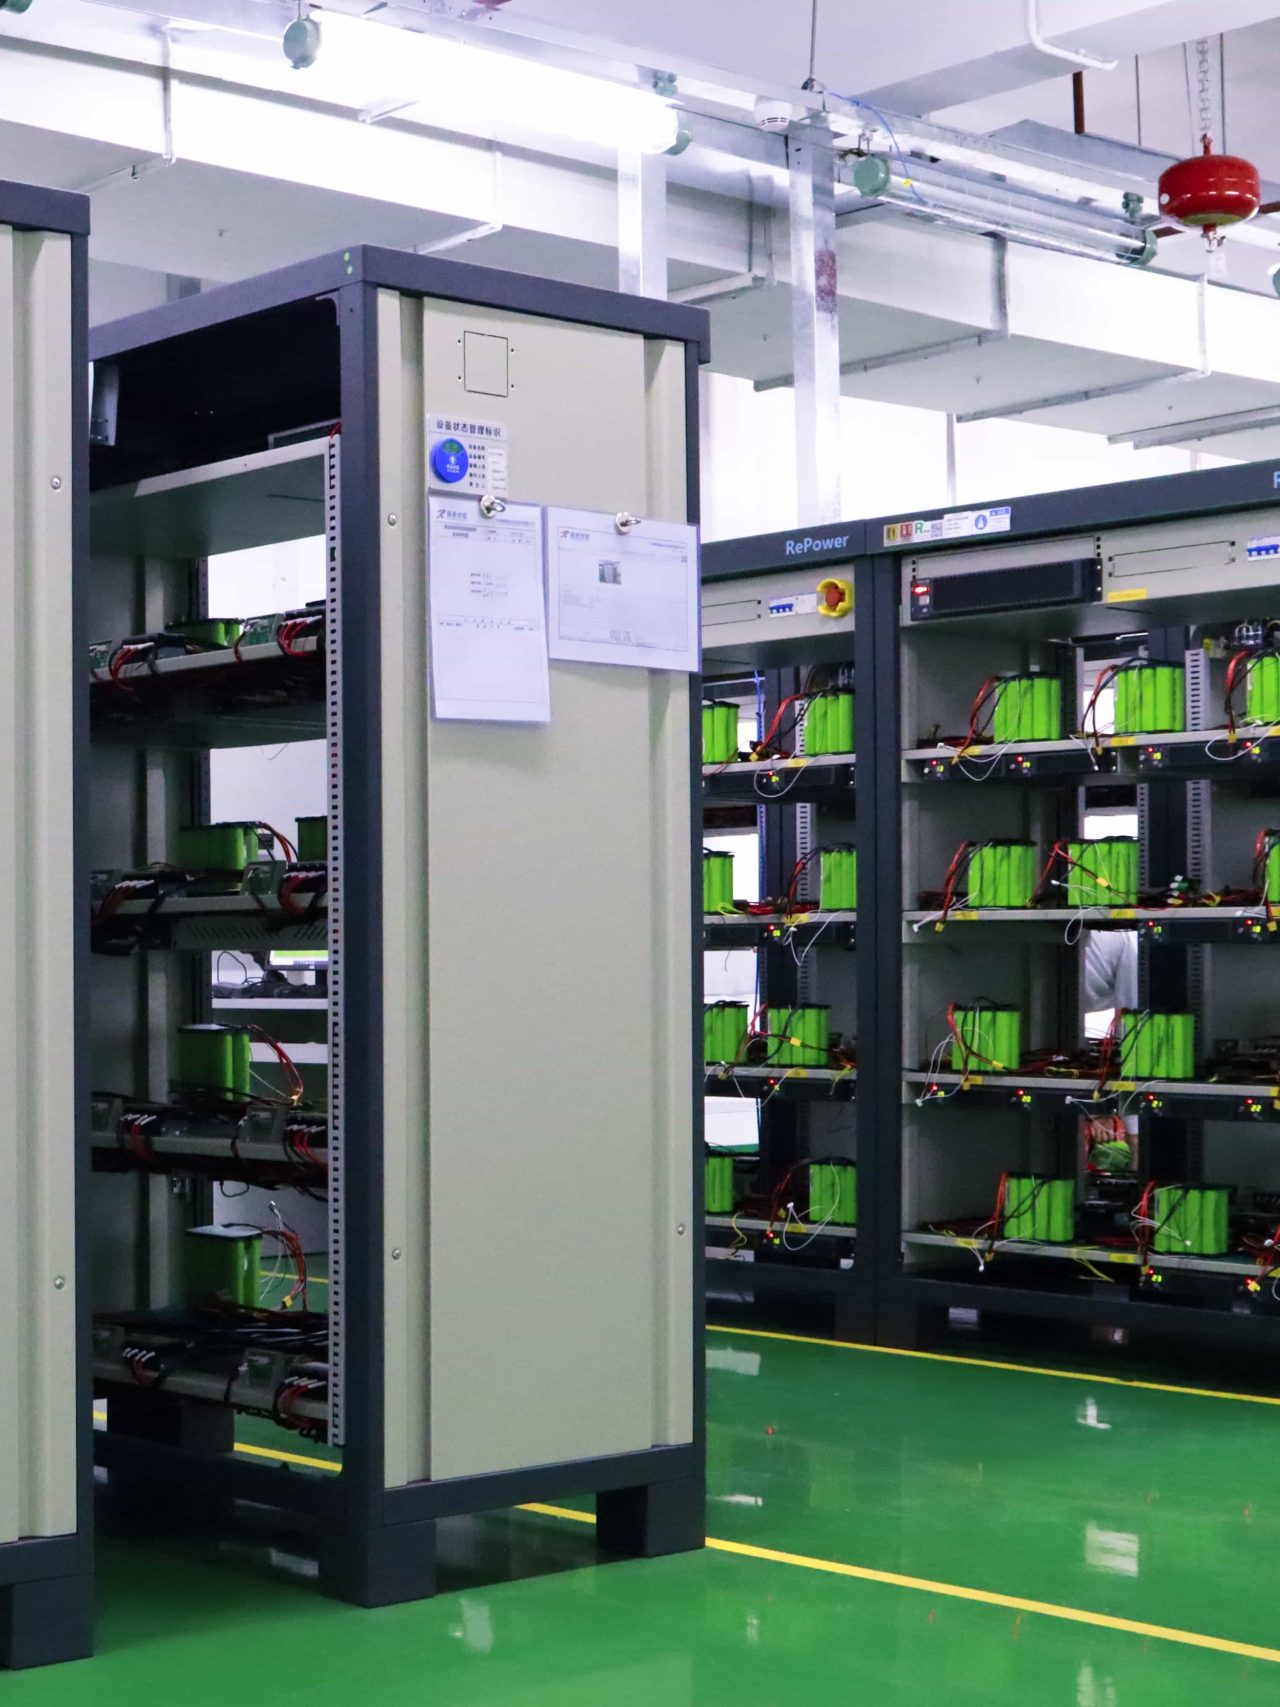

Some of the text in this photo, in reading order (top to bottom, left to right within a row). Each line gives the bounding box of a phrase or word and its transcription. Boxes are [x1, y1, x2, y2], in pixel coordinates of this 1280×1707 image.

[436, 420, 501, 437] 设备状态管理标识
[786, 535, 849, 556] RePower
